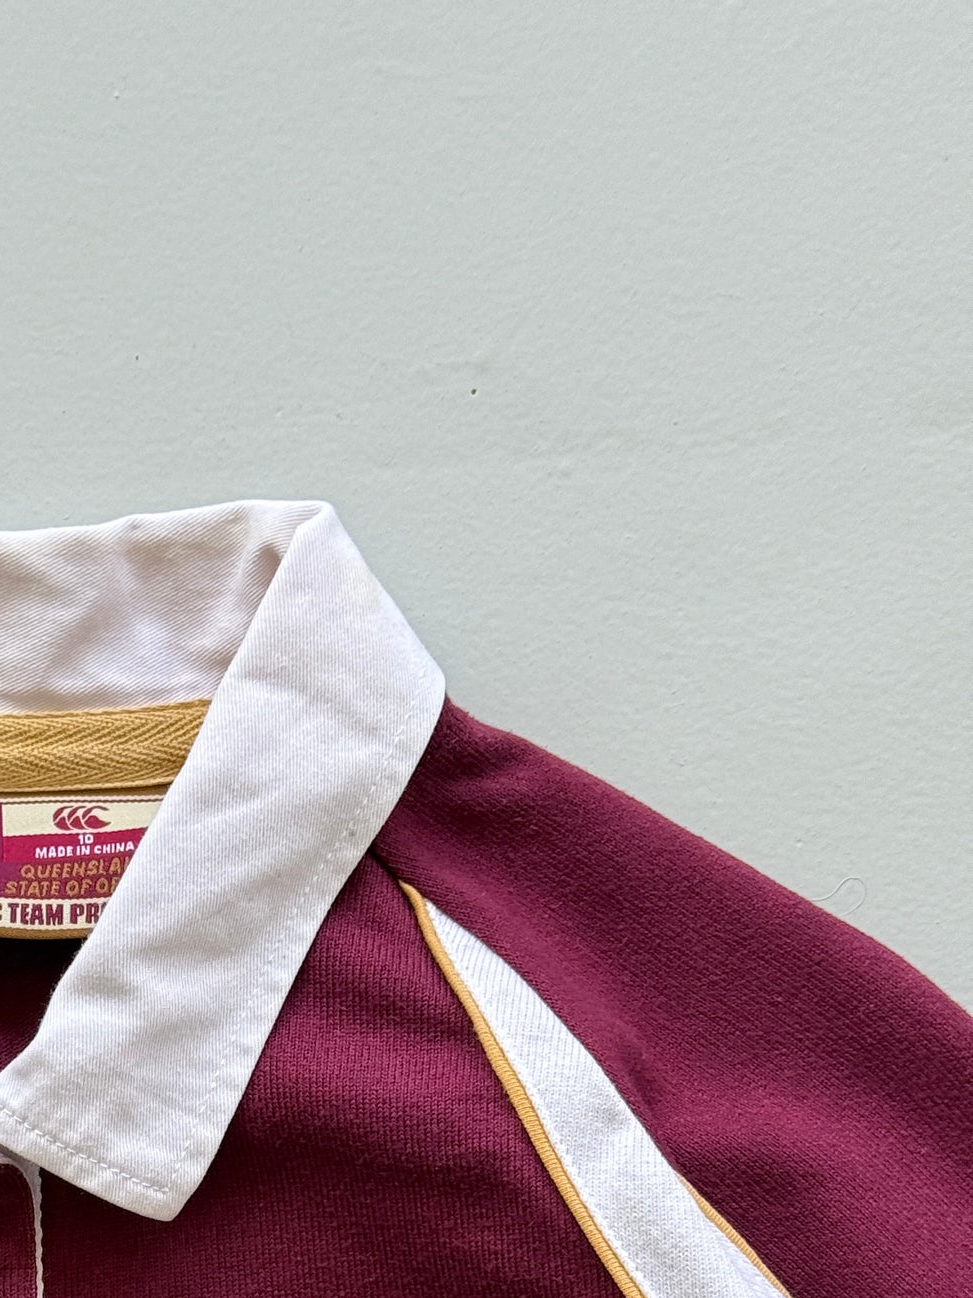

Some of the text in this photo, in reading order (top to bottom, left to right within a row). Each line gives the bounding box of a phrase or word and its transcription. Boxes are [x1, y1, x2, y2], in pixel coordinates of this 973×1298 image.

[35, 841, 135, 859] MADE IN CHINA
[5, 881, 61, 897] STATE
[65, 880, 93, 897] OF
[8, 902, 64, 926] TEAM
